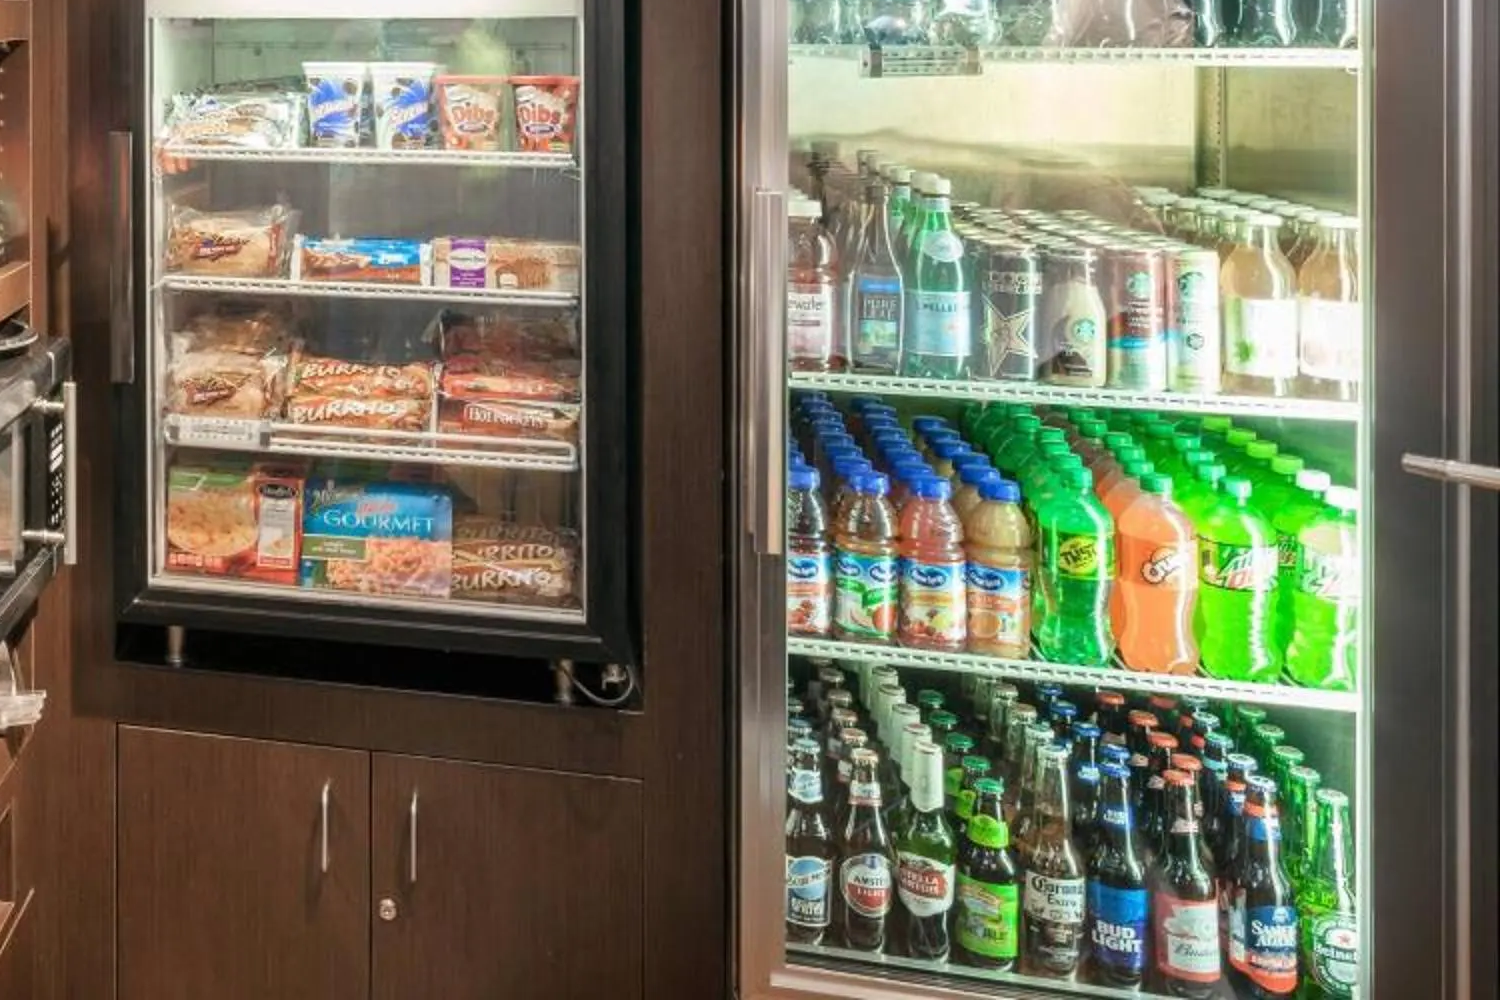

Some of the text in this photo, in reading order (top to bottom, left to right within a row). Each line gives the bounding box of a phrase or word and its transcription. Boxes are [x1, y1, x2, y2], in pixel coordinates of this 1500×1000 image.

[518, 103, 561, 123] Dibs
[323, 509, 435, 533] GOURMET
[1097, 920, 1136, 939] BUD
[1091, 929, 1143, 953] LIGHT
